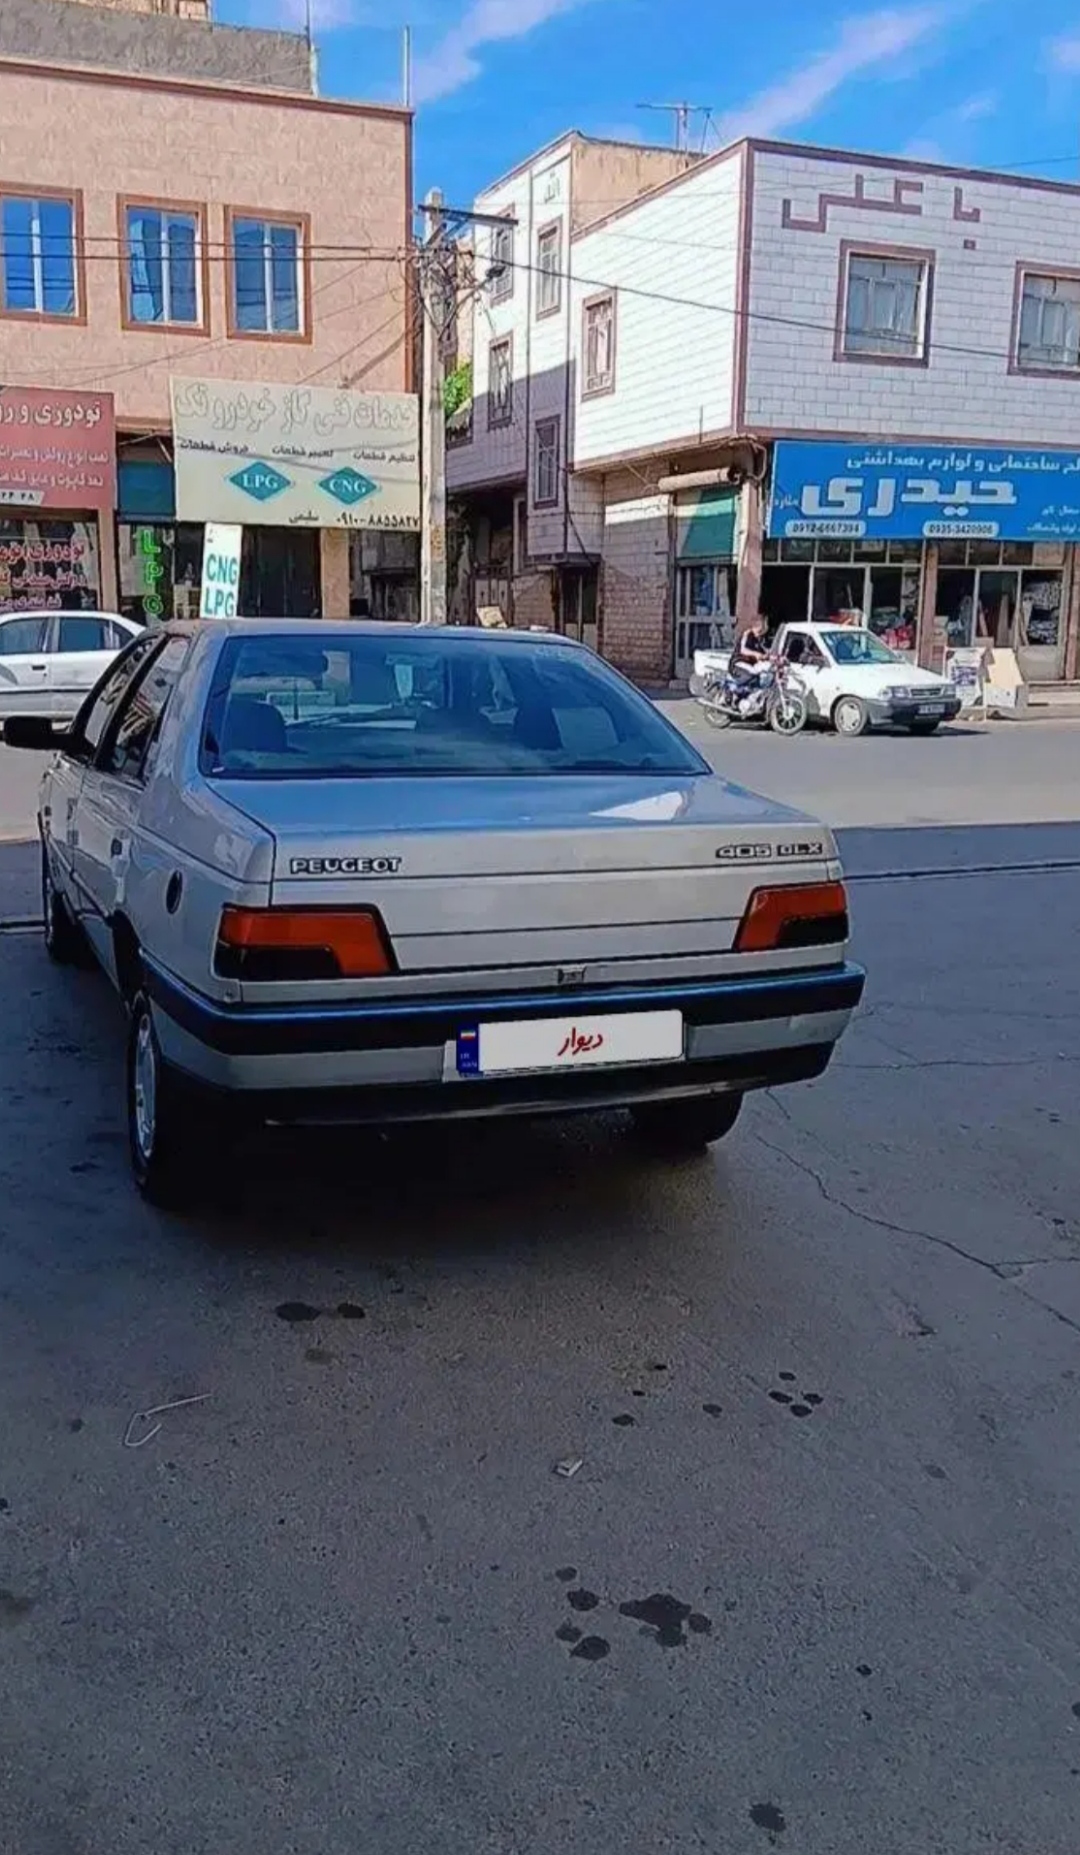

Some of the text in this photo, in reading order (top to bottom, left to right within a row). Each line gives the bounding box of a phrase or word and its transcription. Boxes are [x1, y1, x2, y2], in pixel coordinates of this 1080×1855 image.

[782, 174, 924, 234] علی
[20, 405, 29, 424] و
[35, 401, 101, 429] تودوزی
[280, 388, 312, 435] گاز
[313, 391, 351, 436] فنی
[352, 395, 418, 431] خدمات
[218, 442, 249, 455] فروش
[847, 451, 923, 469] بهداشتی
[928, 452, 972, 472] لوازم
[974, 459, 985, 472] و
[988, 453, 1060, 473] ساختمانی
[243, 474, 279, 489] LPG
[329, 482, 367, 494] CNG
[801, 477, 1018, 517] حیدری
[206, 553, 238, 586] CNG
[204, 587, 235, 618] LPG
[715, 844, 772, 859] 405
[290, 857, 402, 874] PEUGEOT
